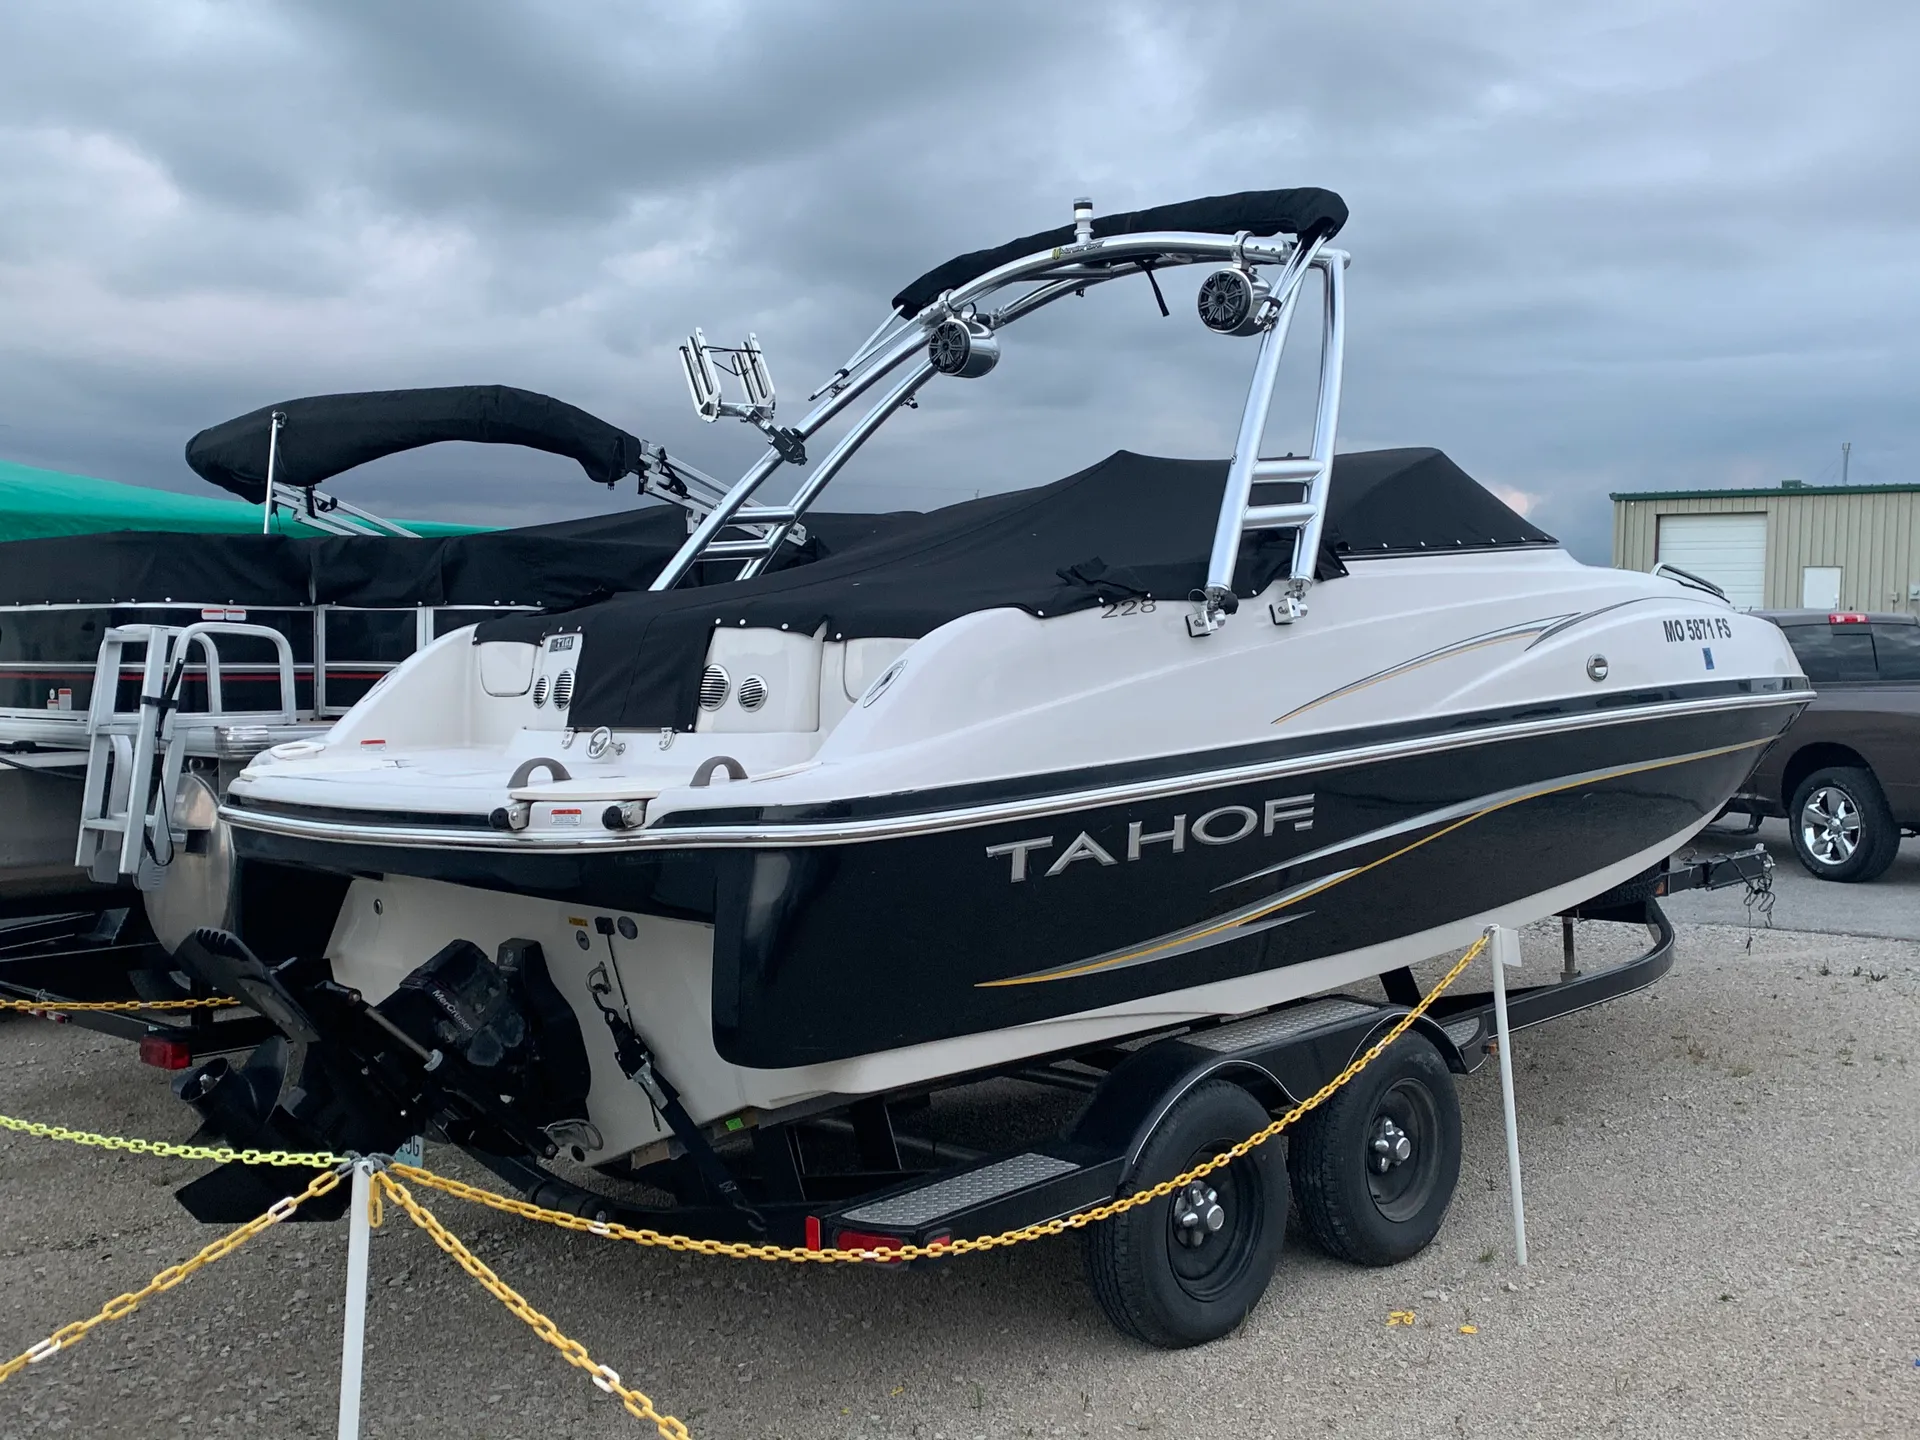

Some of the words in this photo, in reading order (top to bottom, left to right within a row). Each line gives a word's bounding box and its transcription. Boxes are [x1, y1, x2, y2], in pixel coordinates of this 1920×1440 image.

[1101, 597, 1157, 619] 228
[1663, 619, 1685, 643] MO
[1686, 618, 1715, 641] 5871
[1715, 617, 1732, 639] FS
[432, 989, 473, 1032] MerCruiser
